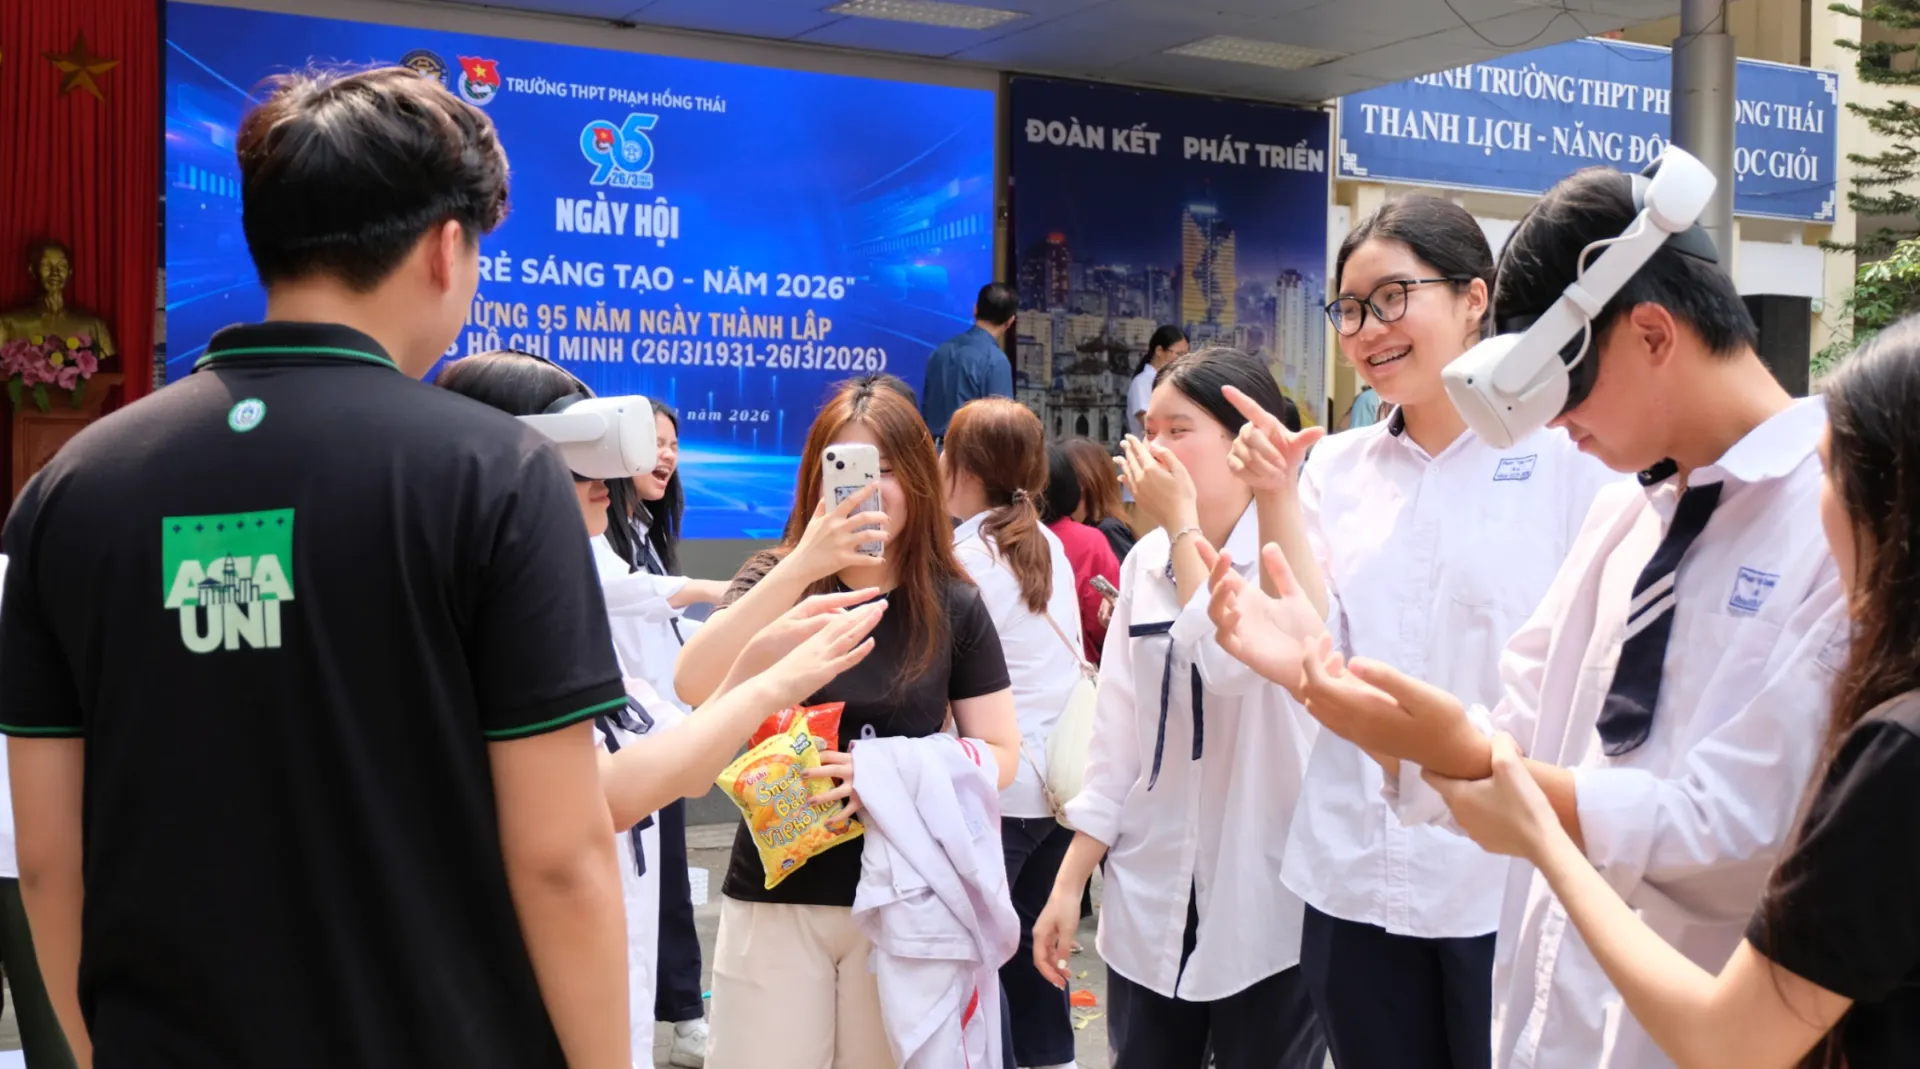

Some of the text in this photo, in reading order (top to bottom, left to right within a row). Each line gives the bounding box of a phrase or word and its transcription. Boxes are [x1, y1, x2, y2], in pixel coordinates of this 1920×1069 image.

[506, 77, 726, 113] TRƯỜNG THPT PHẠM HỒNG THÁI
[1477, 62, 1575, 103] TRƯỜNG
[1578, 78, 1638, 110] THPT
[1642, 86, 1671, 115] PH
[1774, 100, 1824, 134] THÁI
[1025, 117, 1324, 173] ĐOÀN KẾT PHÁT TRIỂN
[1361, 103, 1460, 144] THANH
[1467, 115, 1532, 156] LỊCH
[1552, 120, 1623, 161] NĂNG
[1734, 146, 1766, 182] ỌC
[1769, 146, 1819, 181] GIỎI
[556, 191, 679, 248] NGÀY HỘI
[478, 250, 513, 283] RẺ
[521, 254, 605, 288] SÁNG
[613, 263, 675, 295] TẠO
[703, 265, 768, 297] NĂM
[775, 272, 856, 300] 2026"
[465, 293, 832, 346] ỪNG 95 NĂM NGÀY THÀNH LẬP
[509, 327, 552, 360] CHÍ
[558, 335, 624, 363] MINH
[631, 338, 887, 372] (26/3/1931-26/3/2026)
[686, 408, 722, 421] năm
[728, 408, 770, 423] 2026
[179, 598, 282, 654] UNI
[746, 770, 768, 787] Oishi
[758, 765, 802, 805] Snack
